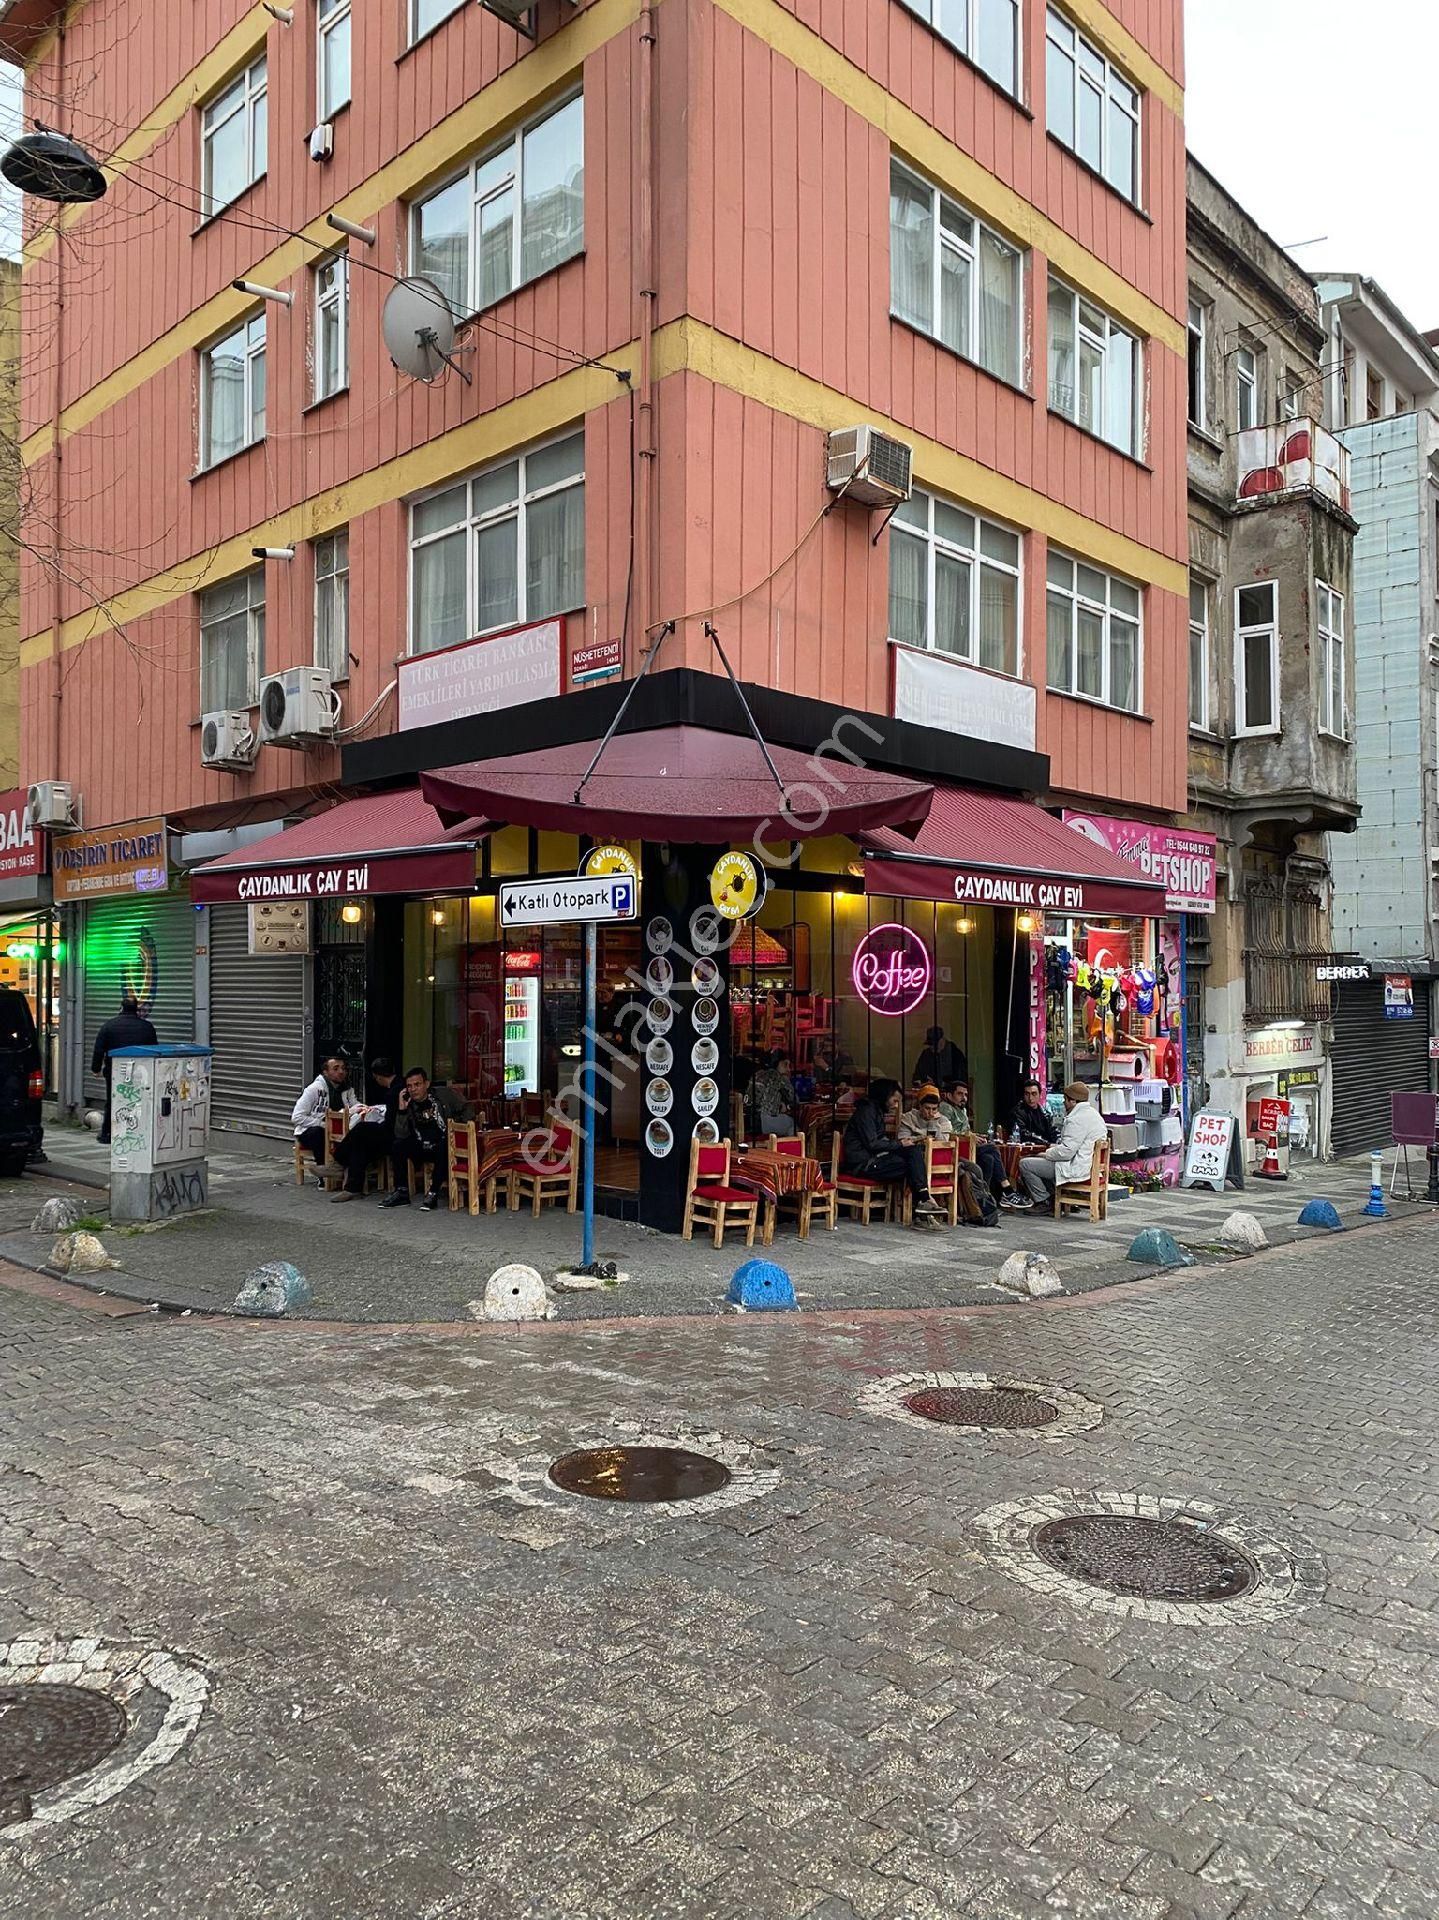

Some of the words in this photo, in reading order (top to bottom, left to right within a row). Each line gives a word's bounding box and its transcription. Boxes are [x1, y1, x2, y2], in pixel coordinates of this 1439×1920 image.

[409, 664, 440, 686] TÜRK
[443, 653, 489, 678] TİCARET
[238, 873, 312, 899] ÇAYDANLIK
[316, 869, 342, 894] ÇAY
[346, 863, 368, 891] EVİ
[954, 875, 1035, 904] ÇAYDANLIK
[1038, 884, 1062, 907] ÇAY
[1064, 885, 1083, 907] EVİ
[518, 893, 549, 910] Katlı
[553, 888, 609, 910] Otopark
[615, 887, 627, 908] P
[856, 949, 925, 997] Coffee
[1200, 1117, 1226, 1131] PET
[1193, 1131, 1227, 1146] SHOP
[1191, 1164, 1219, 1176] EMMA
